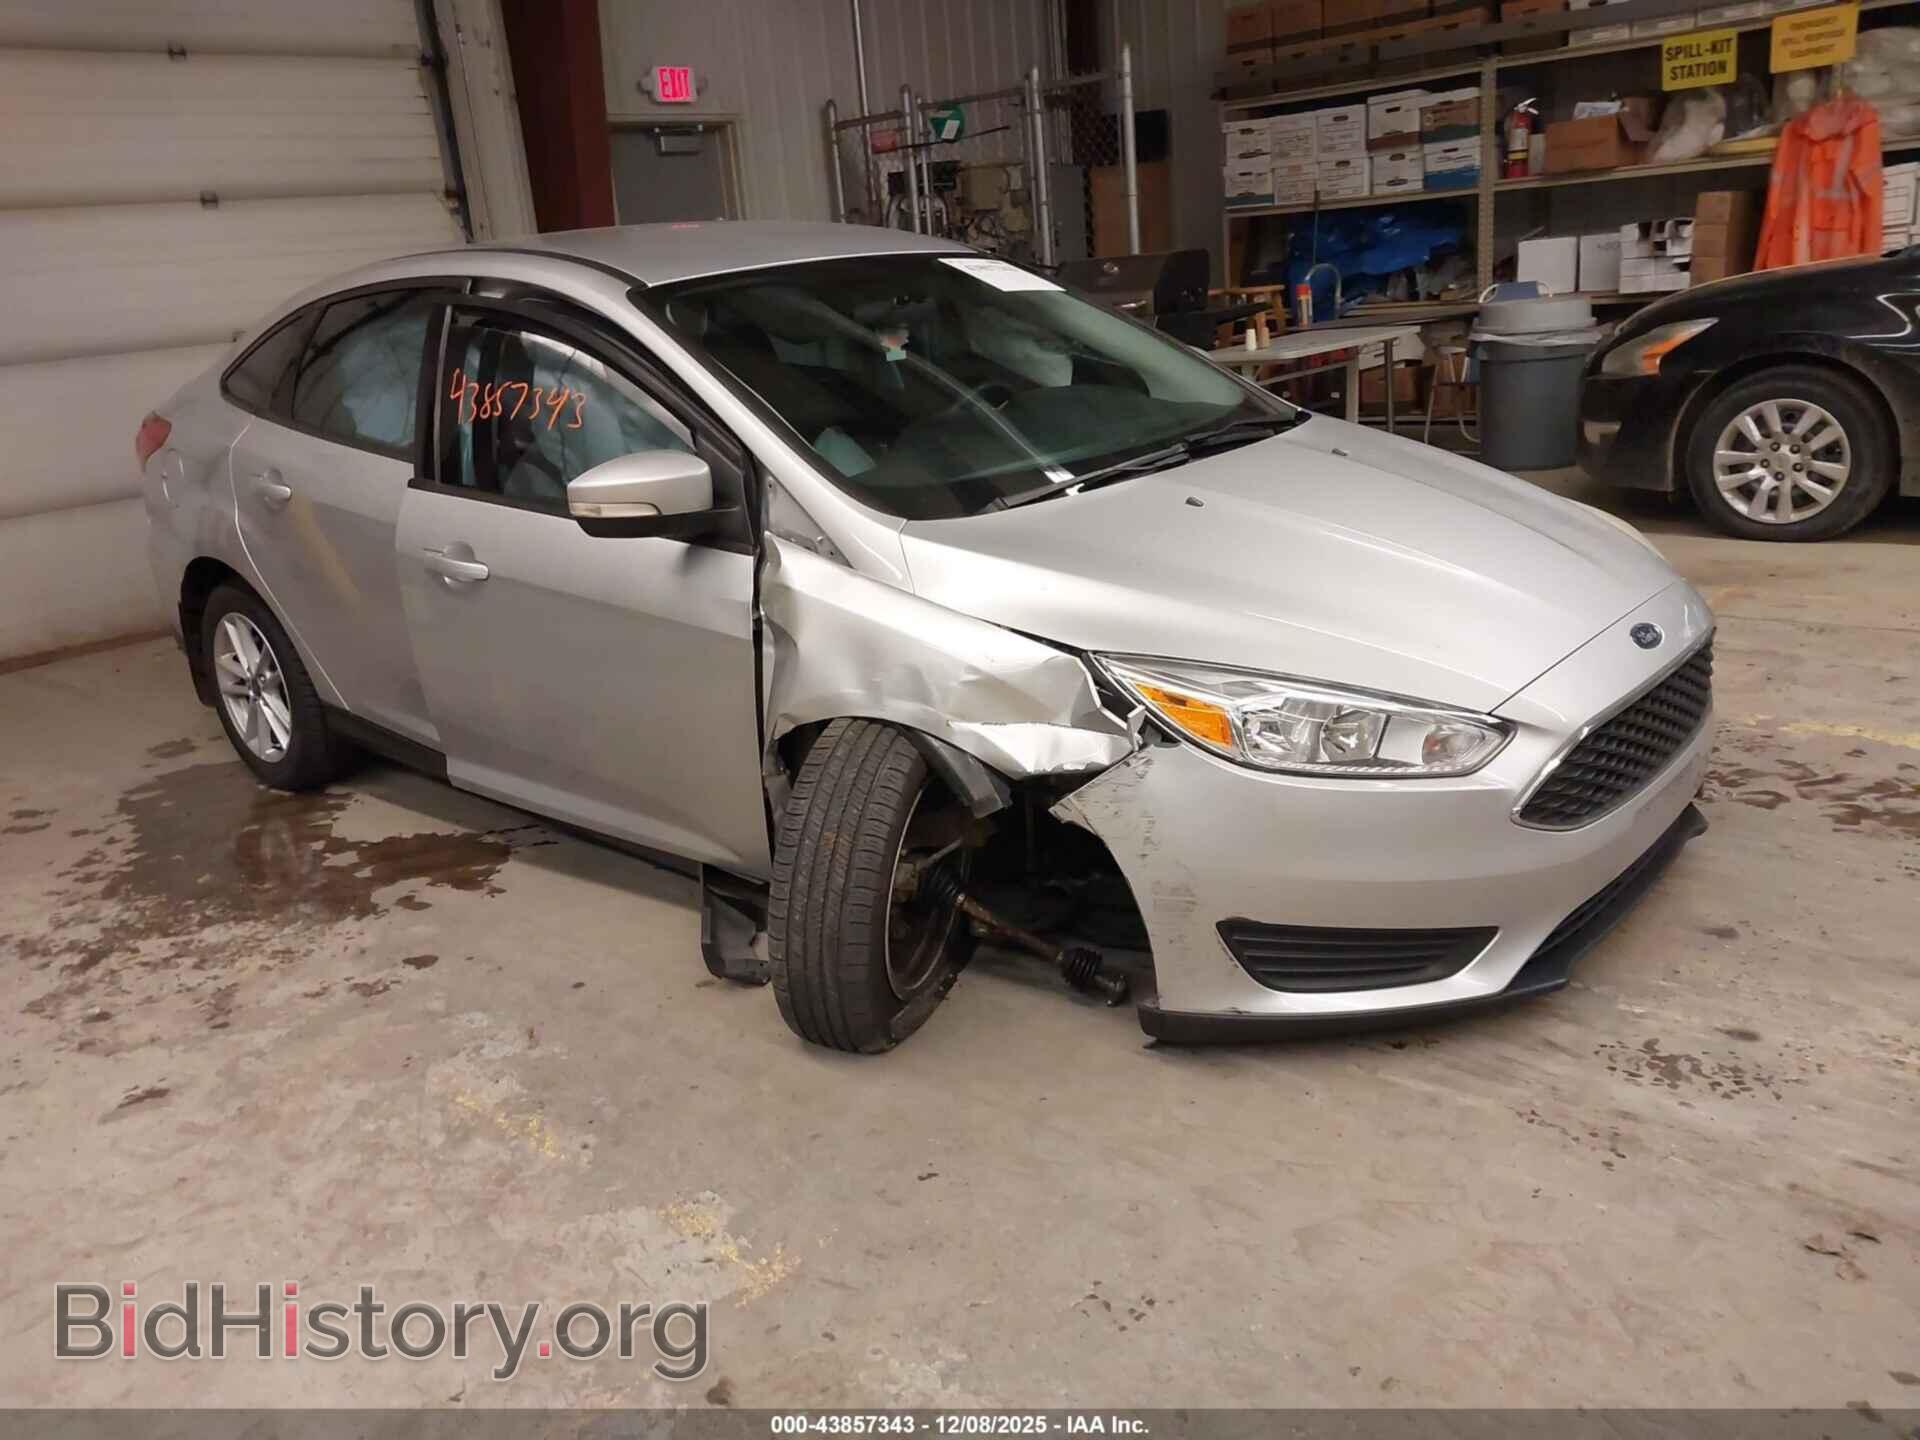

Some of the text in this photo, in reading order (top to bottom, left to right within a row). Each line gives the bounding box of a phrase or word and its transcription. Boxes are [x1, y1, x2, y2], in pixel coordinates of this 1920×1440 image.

[1665, 38, 1733, 62] SPILL-KIT
[659, 68, 690, 98] EXIT
[1669, 59, 1728, 81] STATION
[450, 367, 586, 431] 43857343
